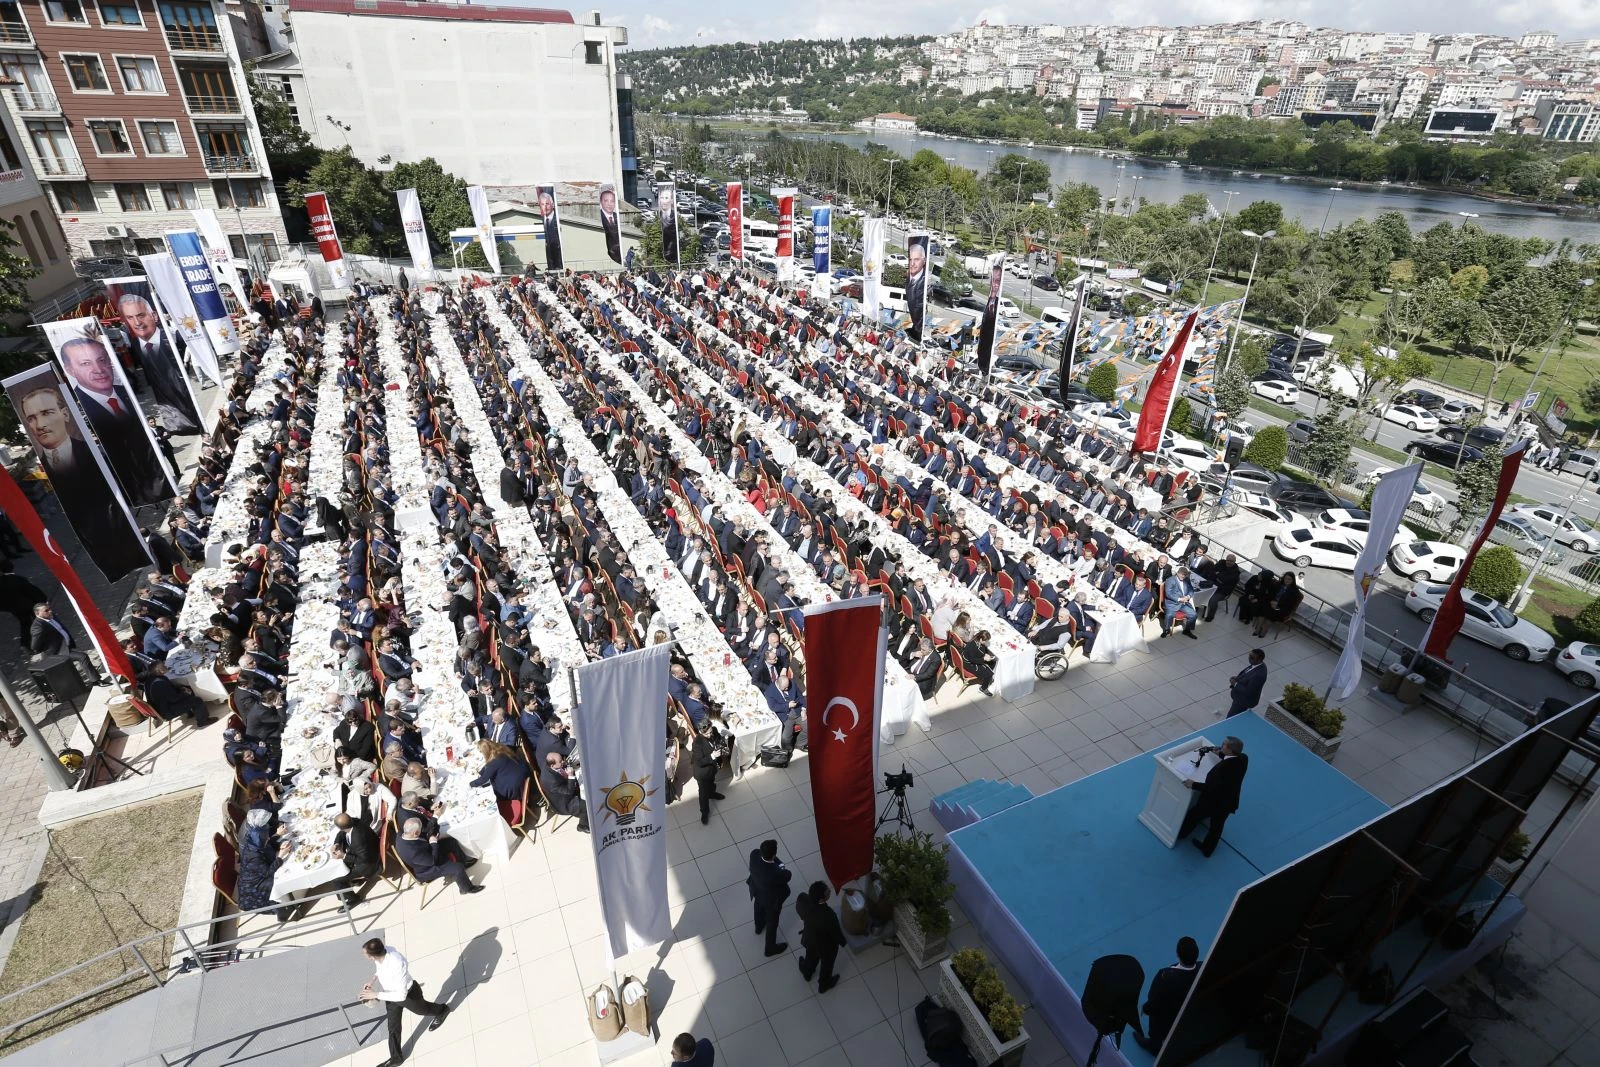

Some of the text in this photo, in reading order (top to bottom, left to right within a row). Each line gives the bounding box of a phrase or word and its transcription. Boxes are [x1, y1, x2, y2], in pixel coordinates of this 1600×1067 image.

[185, 268, 211, 282] İRADE
[602, 824, 653, 845] AK PARTİ
